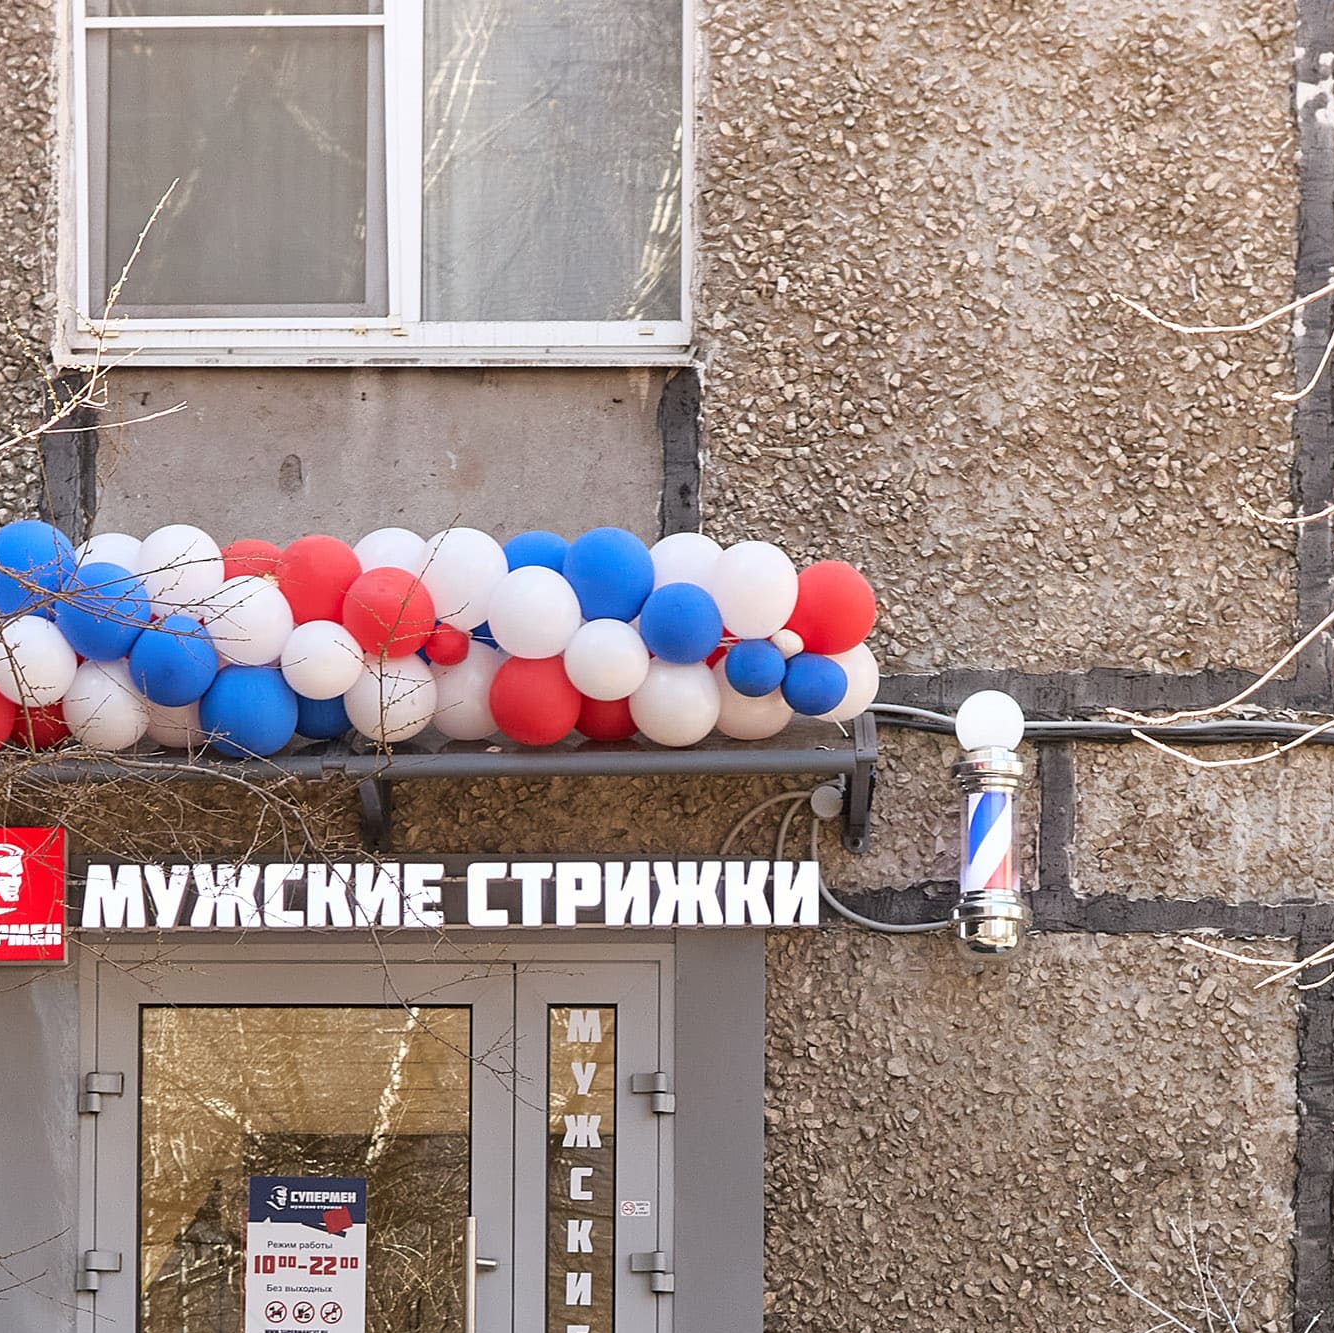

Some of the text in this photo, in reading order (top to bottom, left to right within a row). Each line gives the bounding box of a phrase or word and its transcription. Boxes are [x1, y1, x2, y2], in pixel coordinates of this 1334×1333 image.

[81, 860, 820, 930] МУЖСКИЕ СТРИЖКИ
[290, 1191, 357, 1203] СУПЕРМЕН
[267, 1240, 333, 1250] Режим работы
[266, 1284, 333, 1294] Без выходных
